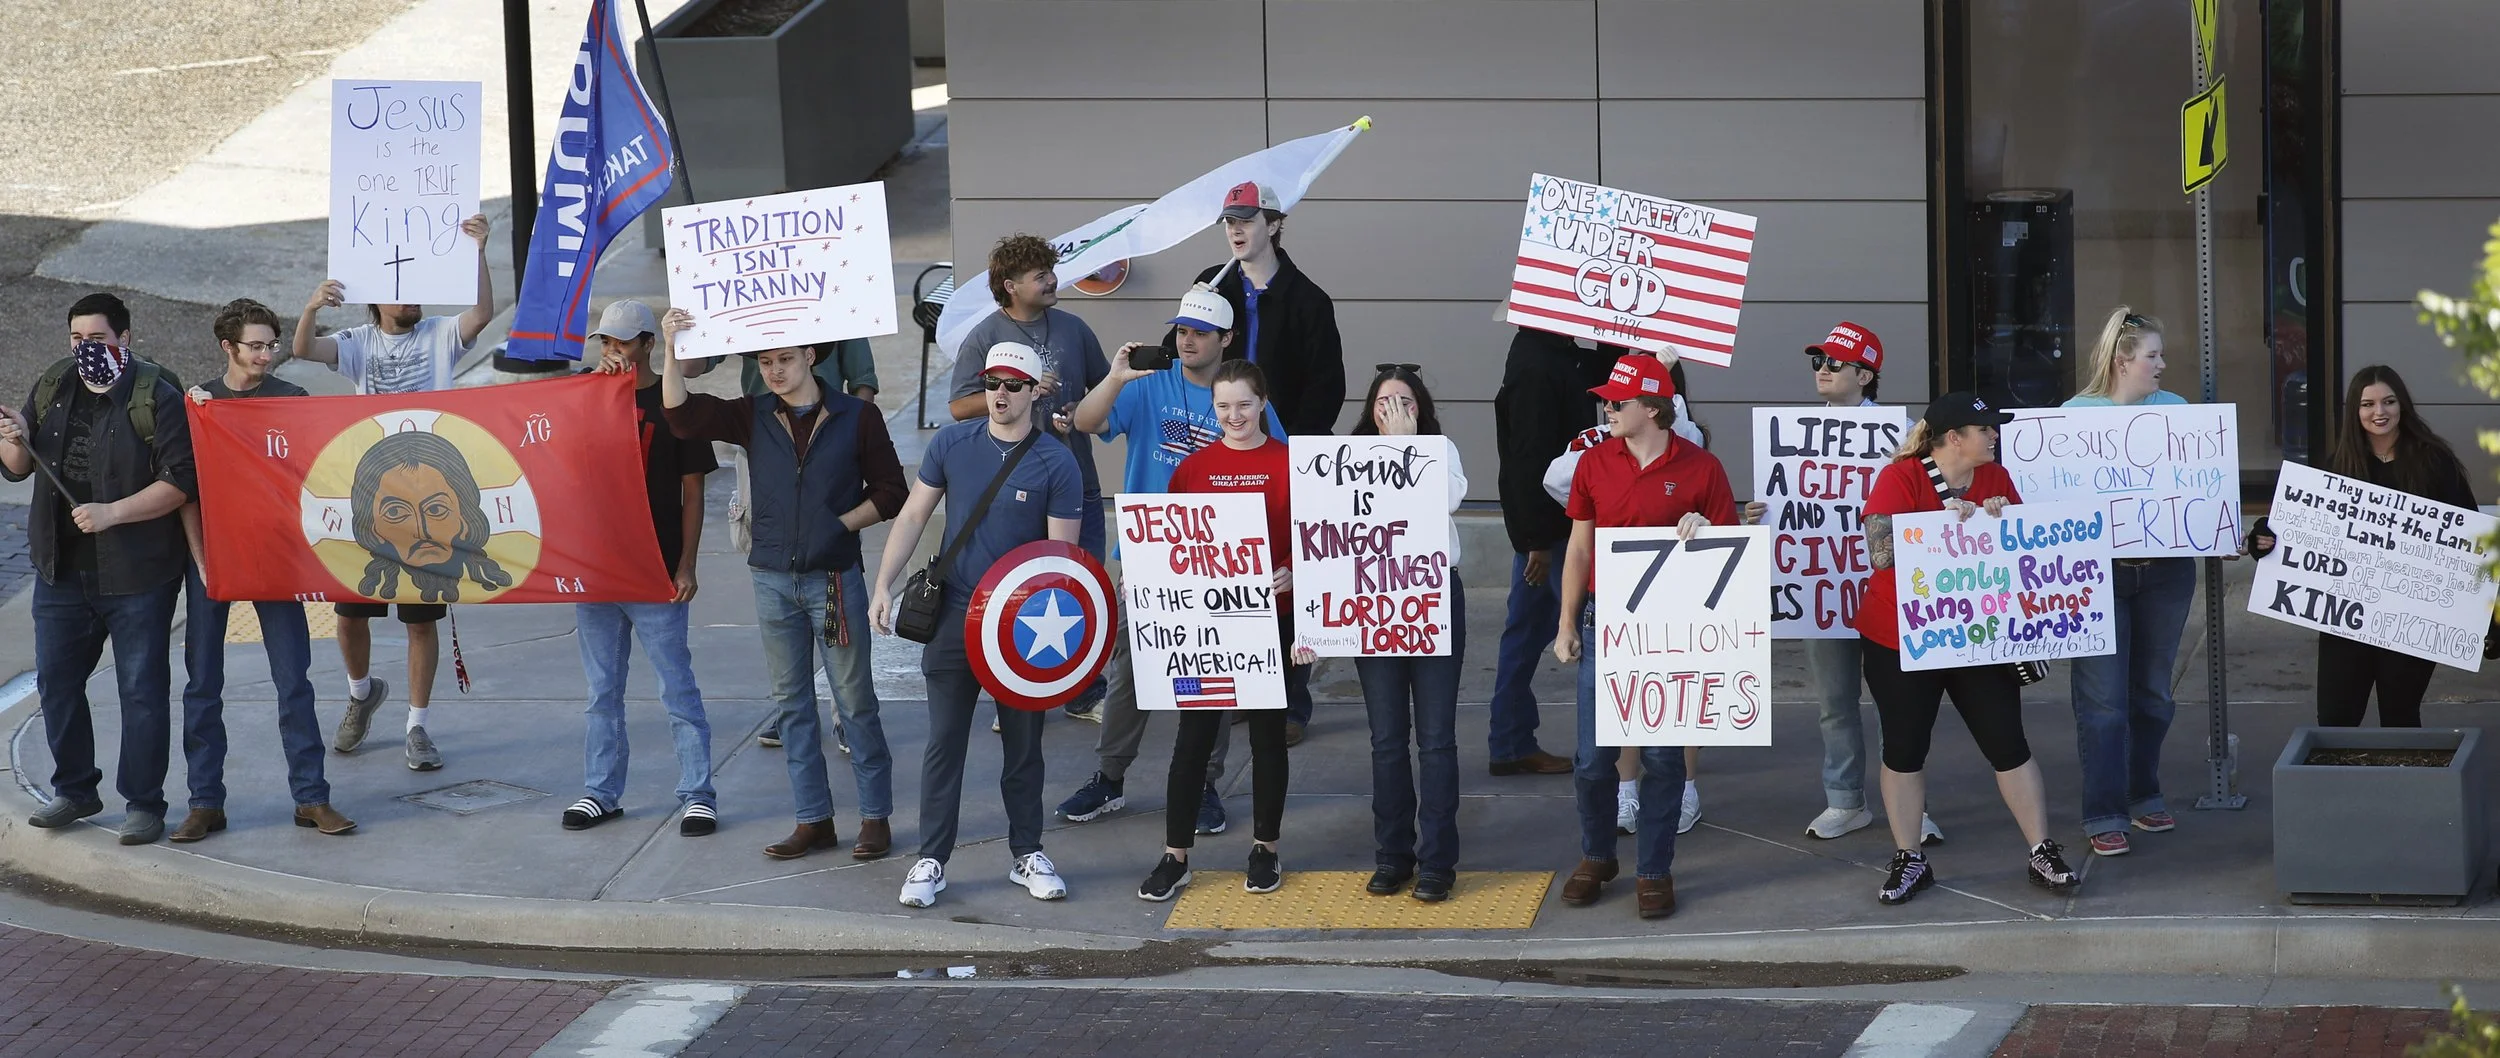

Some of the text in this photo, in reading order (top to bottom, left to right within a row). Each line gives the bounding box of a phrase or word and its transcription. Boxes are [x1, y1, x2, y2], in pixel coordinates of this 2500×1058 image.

[348, 86, 465, 132] Jesus
[376, 137, 440, 158] is the
[358, 164, 460, 195] one TRUE
[1542, 178, 1715, 239] ONE NATION
[683, 206, 843, 253] TRADITION
[1554, 217, 1656, 268] UNDER
[733, 242, 796, 274] ISN'T
[693, 271, 826, 310] TYRANNY
[1574, 258, 1666, 317] GOD
[1612, 316, 1642, 341] 1776
[1172, 407, 1195, 420] TRUE
[1770, 416, 1900, 458] LIFE IS
[2013, 412, 2228, 467] Jesus Christ
[1766, 459, 1876, 501] A GIFT
[2018, 470, 2039, 493] is
[2049, 465, 2085, 489] the
[2094, 466, 2155, 490] ONLY
[1779, 500, 1825, 531] AND
[2284, 485, 2325, 509] war
[2326, 499, 2398, 529] against
[2401, 517, 2432, 542] the
[2323, 474, 2465, 529] They will wage
[1122, 504, 1216, 544] JESUS
[2000, 511, 2103, 551] blessed
[2110, 496, 2242, 551] ERICA!
[2274, 502, 2307, 528] but
[2310, 511, 2341, 537] the
[2346, 521, 2396, 550] Lamb
[2400, 541, 2433, 560] will
[1611, 537, 1751, 613] 77
[1774, 534, 1873, 576] GIVE
[1936, 561, 2011, 593] only
[2018, 554, 2104, 591] Ruler,
[2283, 528, 2481, 595] over them because he is
[2281, 546, 2455, 608] LORD OF LORDS
[2327, 579, 2381, 603] AND
[1204, 585, 1271, 612] ONLY
[1322, 592, 1395, 627] LORD
[1401, 592, 1441, 623] OF
[1771, 583, 1803, 621] IS
[1902, 596, 1974, 630] King
[2017, 587, 2094, 619] Kings
[1198, 625, 1220, 647] in
[1603, 621, 1766, 658] MILLION+
[2268, 580, 2480, 661] KING OF KINGS
[1903, 624, 1967, 660] Lord
[1980, 634, 2062, 661] Timothy
[2066, 632, 2106, 653] 6:15
[2378, 640, 2392, 648] NIV
[1604, 670, 1761, 737] VOTES
